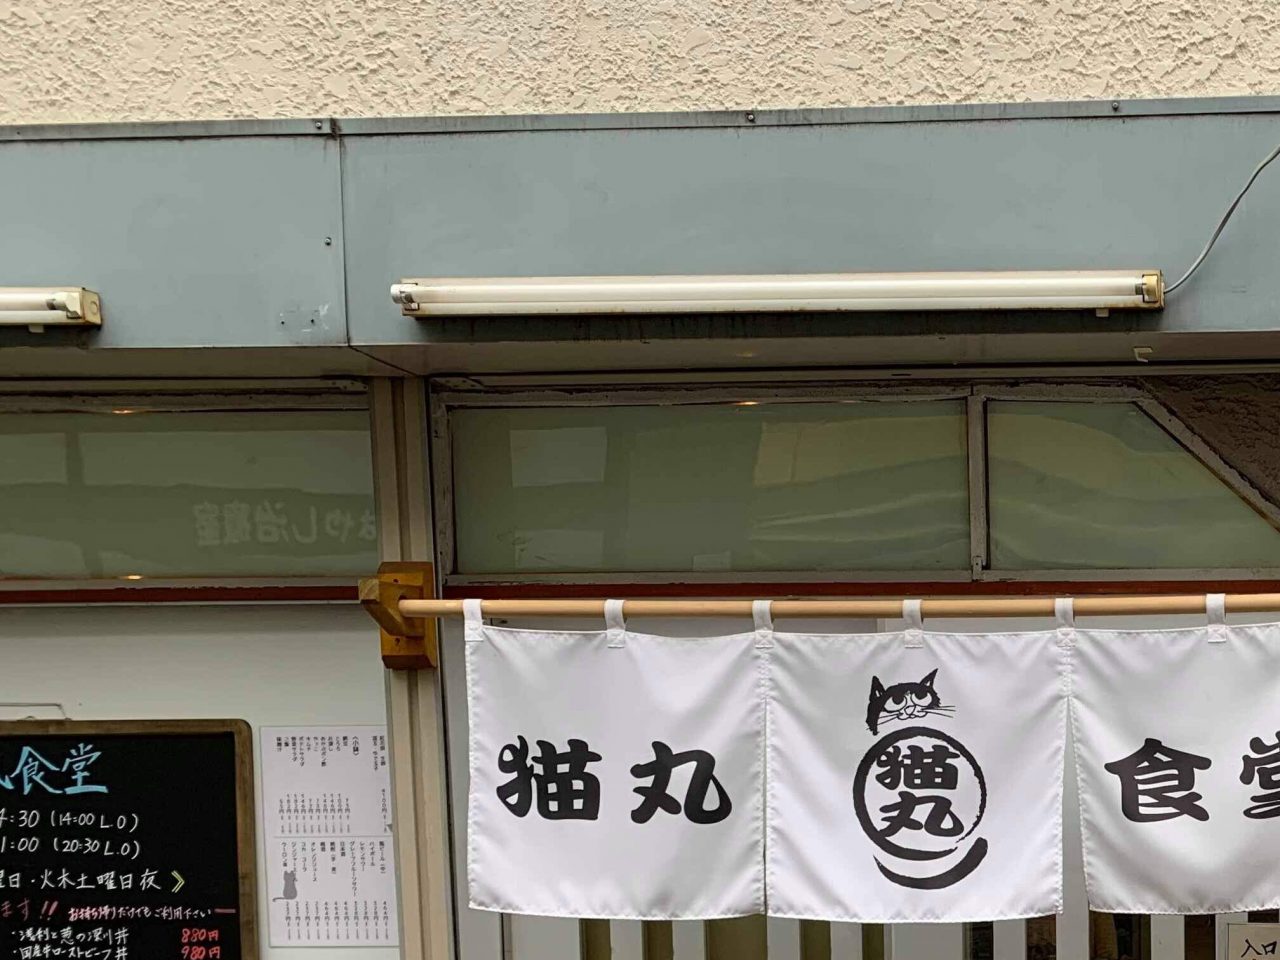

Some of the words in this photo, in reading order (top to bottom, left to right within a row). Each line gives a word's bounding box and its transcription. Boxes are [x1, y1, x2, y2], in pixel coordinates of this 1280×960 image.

[496, 735, 732, 824] 猫丸
[875, 744, 965, 837] 猫丸
[181, 928, 219, 942] 880円
[181, 946, 221, 960] 980円
